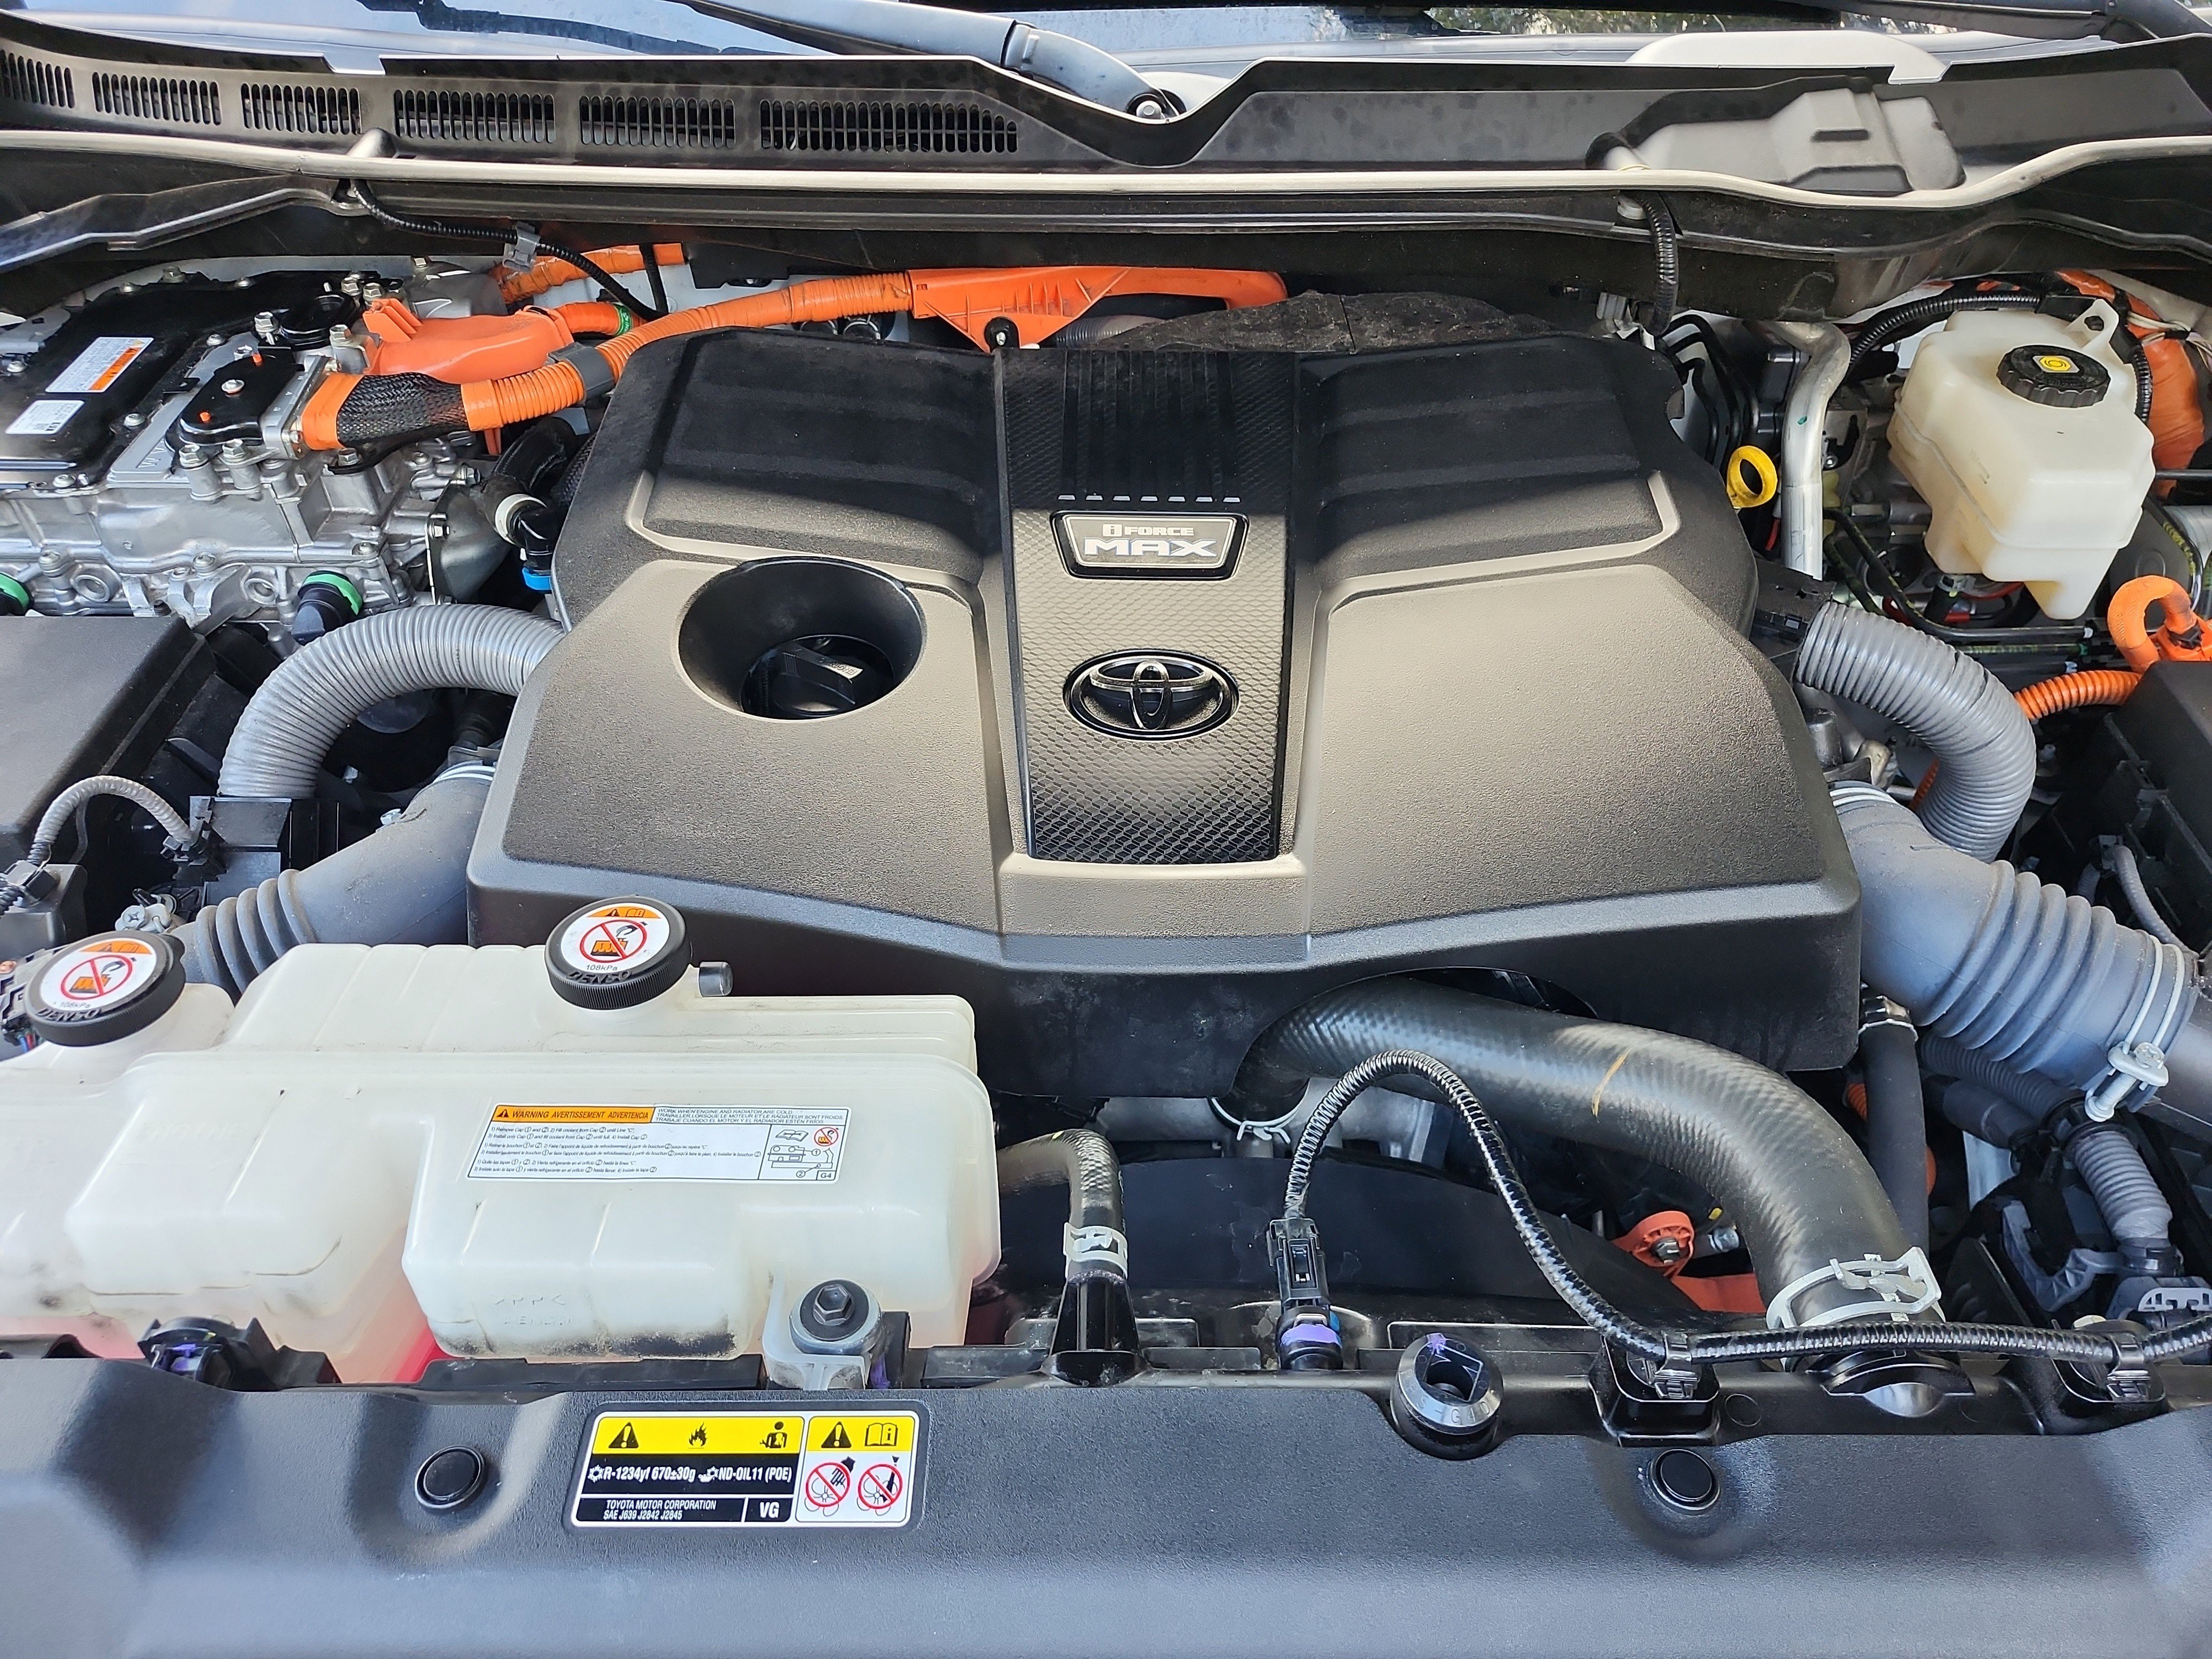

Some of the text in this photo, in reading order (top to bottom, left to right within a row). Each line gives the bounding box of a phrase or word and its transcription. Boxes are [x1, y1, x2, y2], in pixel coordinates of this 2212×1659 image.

[1124, 526, 1194, 536] FORCE
[1084, 537, 1218, 557] MAX
[566, 969, 632, 985] DENSO
[35, 1008, 102, 1022] DENSO
[603, 1466, 792, 1483] R-1234yf 670±30g ND-OIL11 (POE)
[606, 1500, 717, 1510] TOYOTA MOTOR CORPORATION
[760, 1501, 780, 1519] VG
[603, 1509, 683, 1520] SAE J639 J2842 J2845
